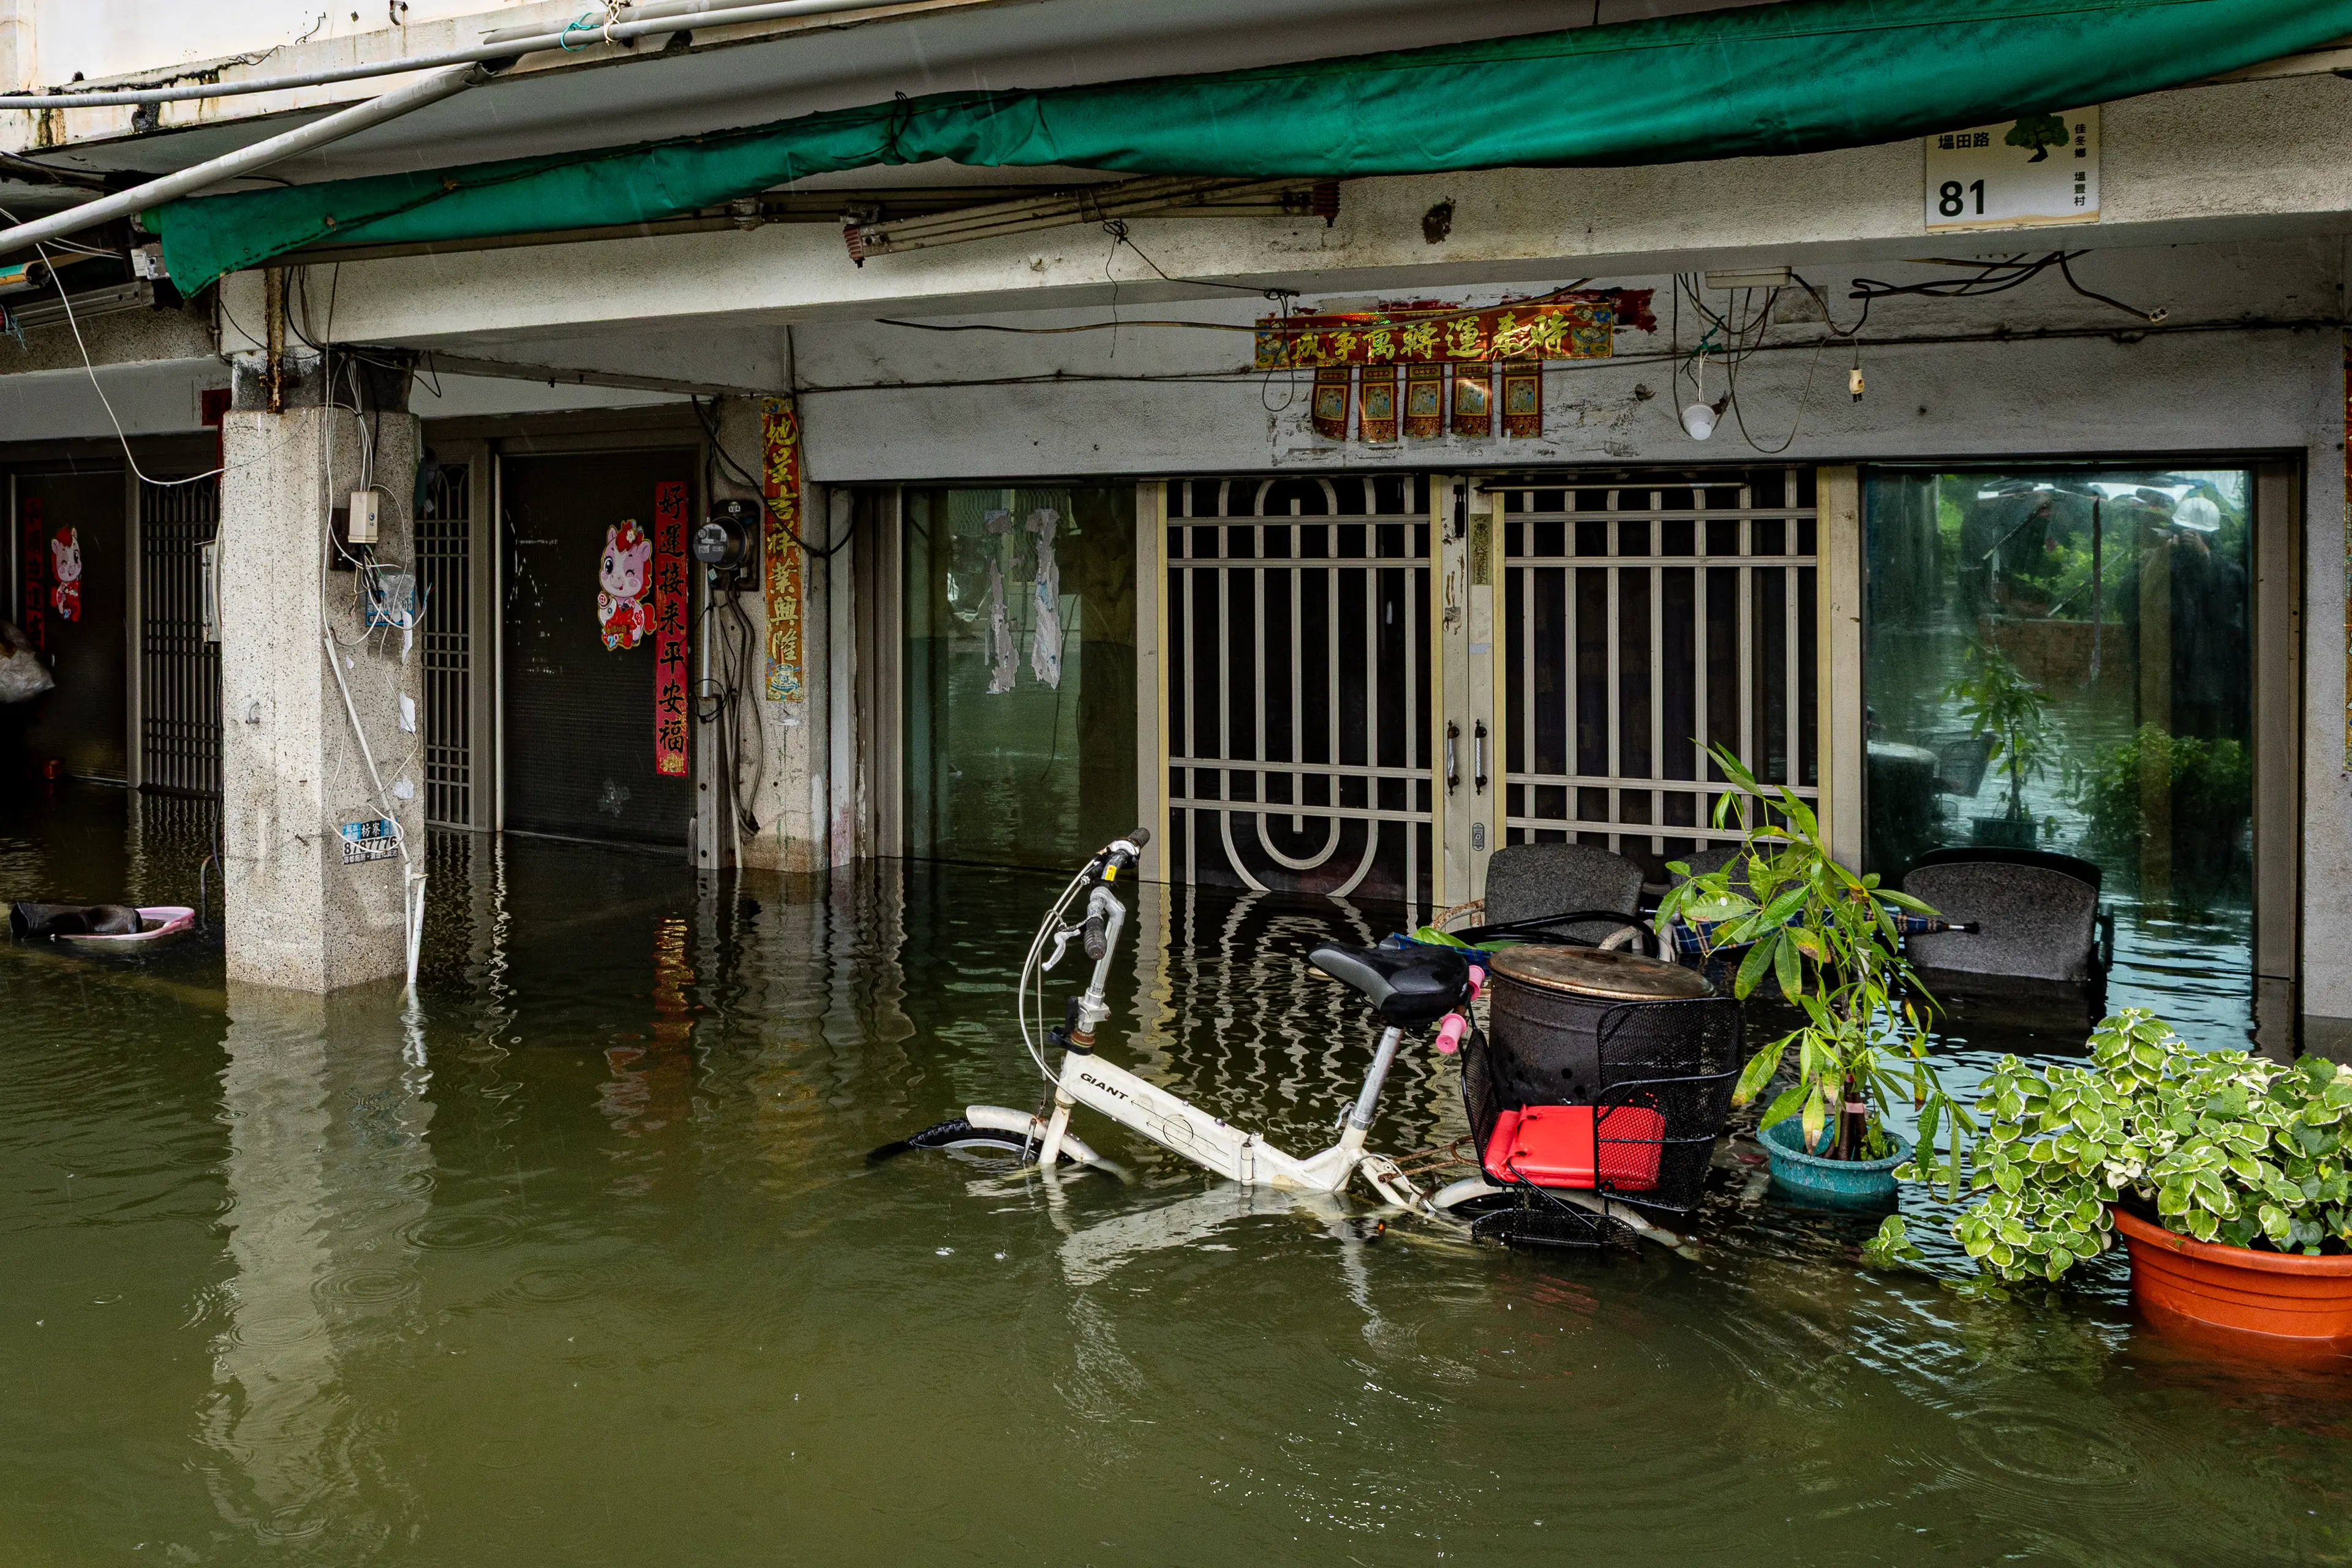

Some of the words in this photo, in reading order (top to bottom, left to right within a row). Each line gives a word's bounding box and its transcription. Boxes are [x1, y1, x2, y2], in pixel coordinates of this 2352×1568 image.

[2074, 123, 2087, 159] 佳冬鄉
[1939, 179, 1985, 217] 81
[344, 835, 398, 854] 8787776
[1080, 1072, 1128, 1100] GIANT
